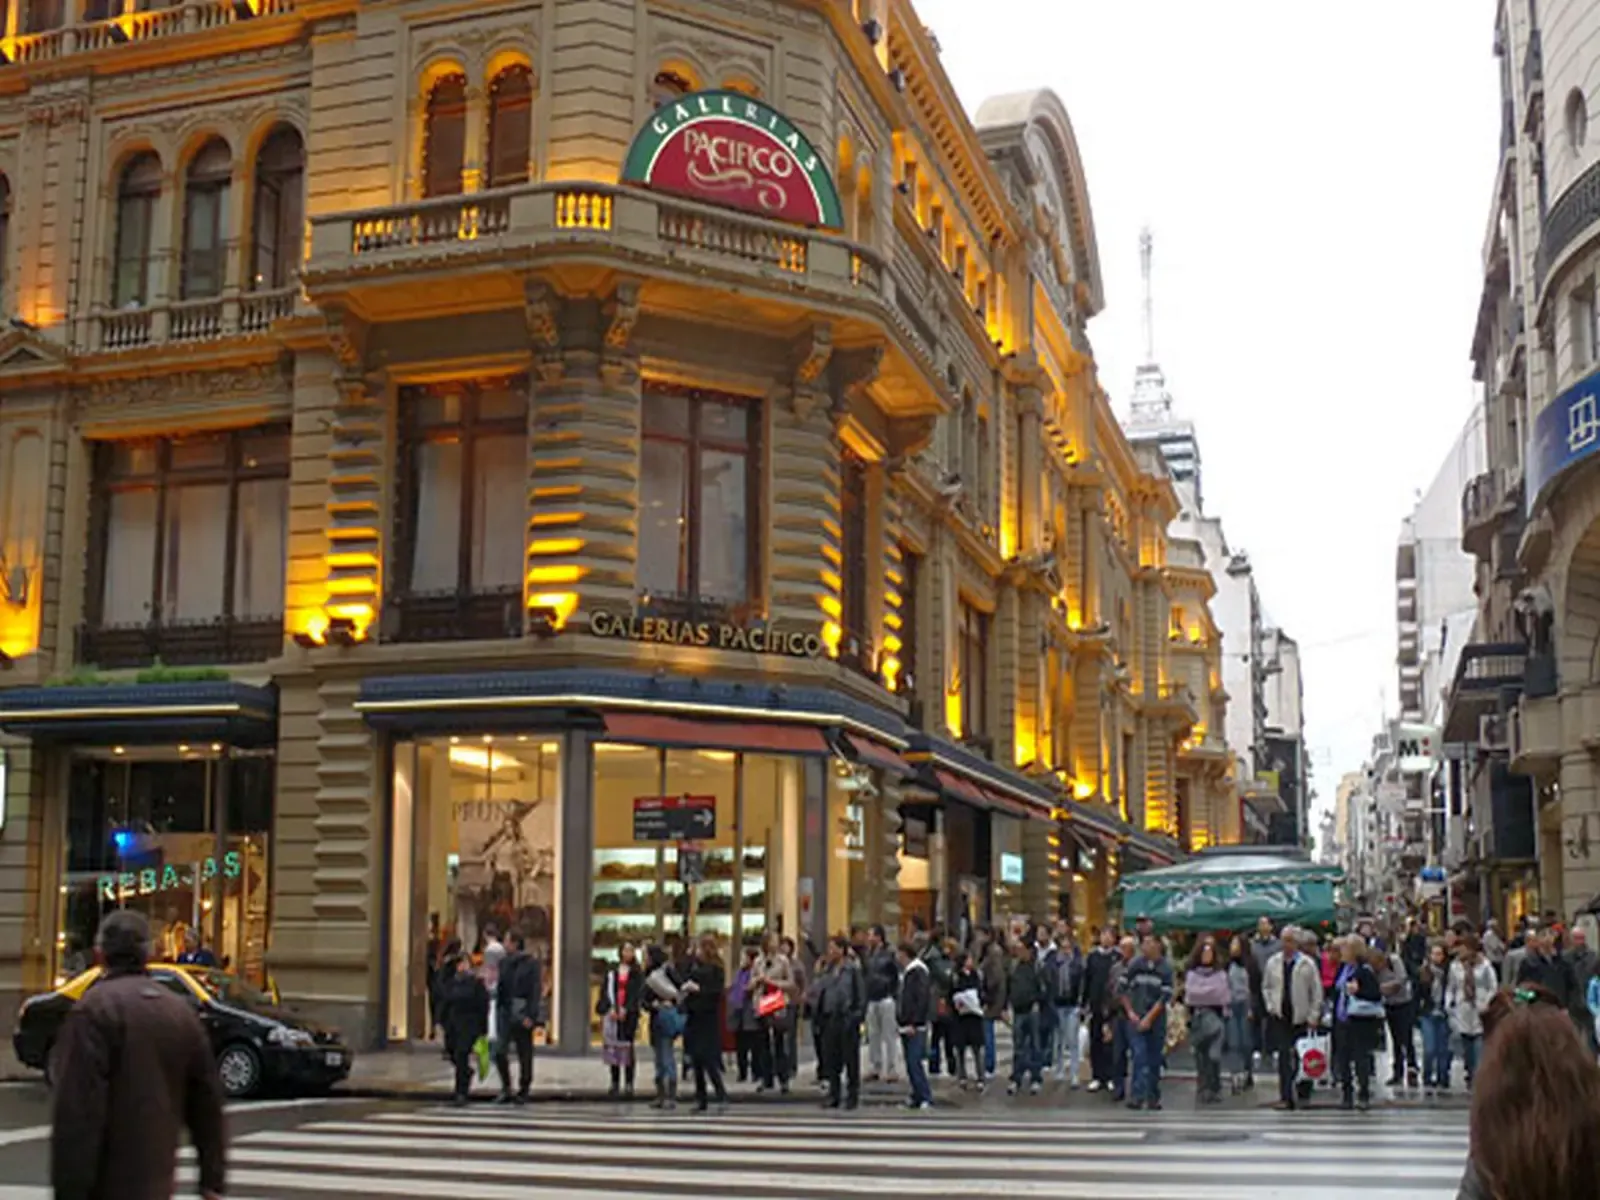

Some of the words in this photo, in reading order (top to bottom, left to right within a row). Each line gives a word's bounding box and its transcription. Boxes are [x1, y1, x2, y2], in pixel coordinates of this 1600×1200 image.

[652, 96, 818, 172] GALERIAS
[684, 129, 794, 178] PACIFICO
[591, 611, 710, 645] GALERIAS
